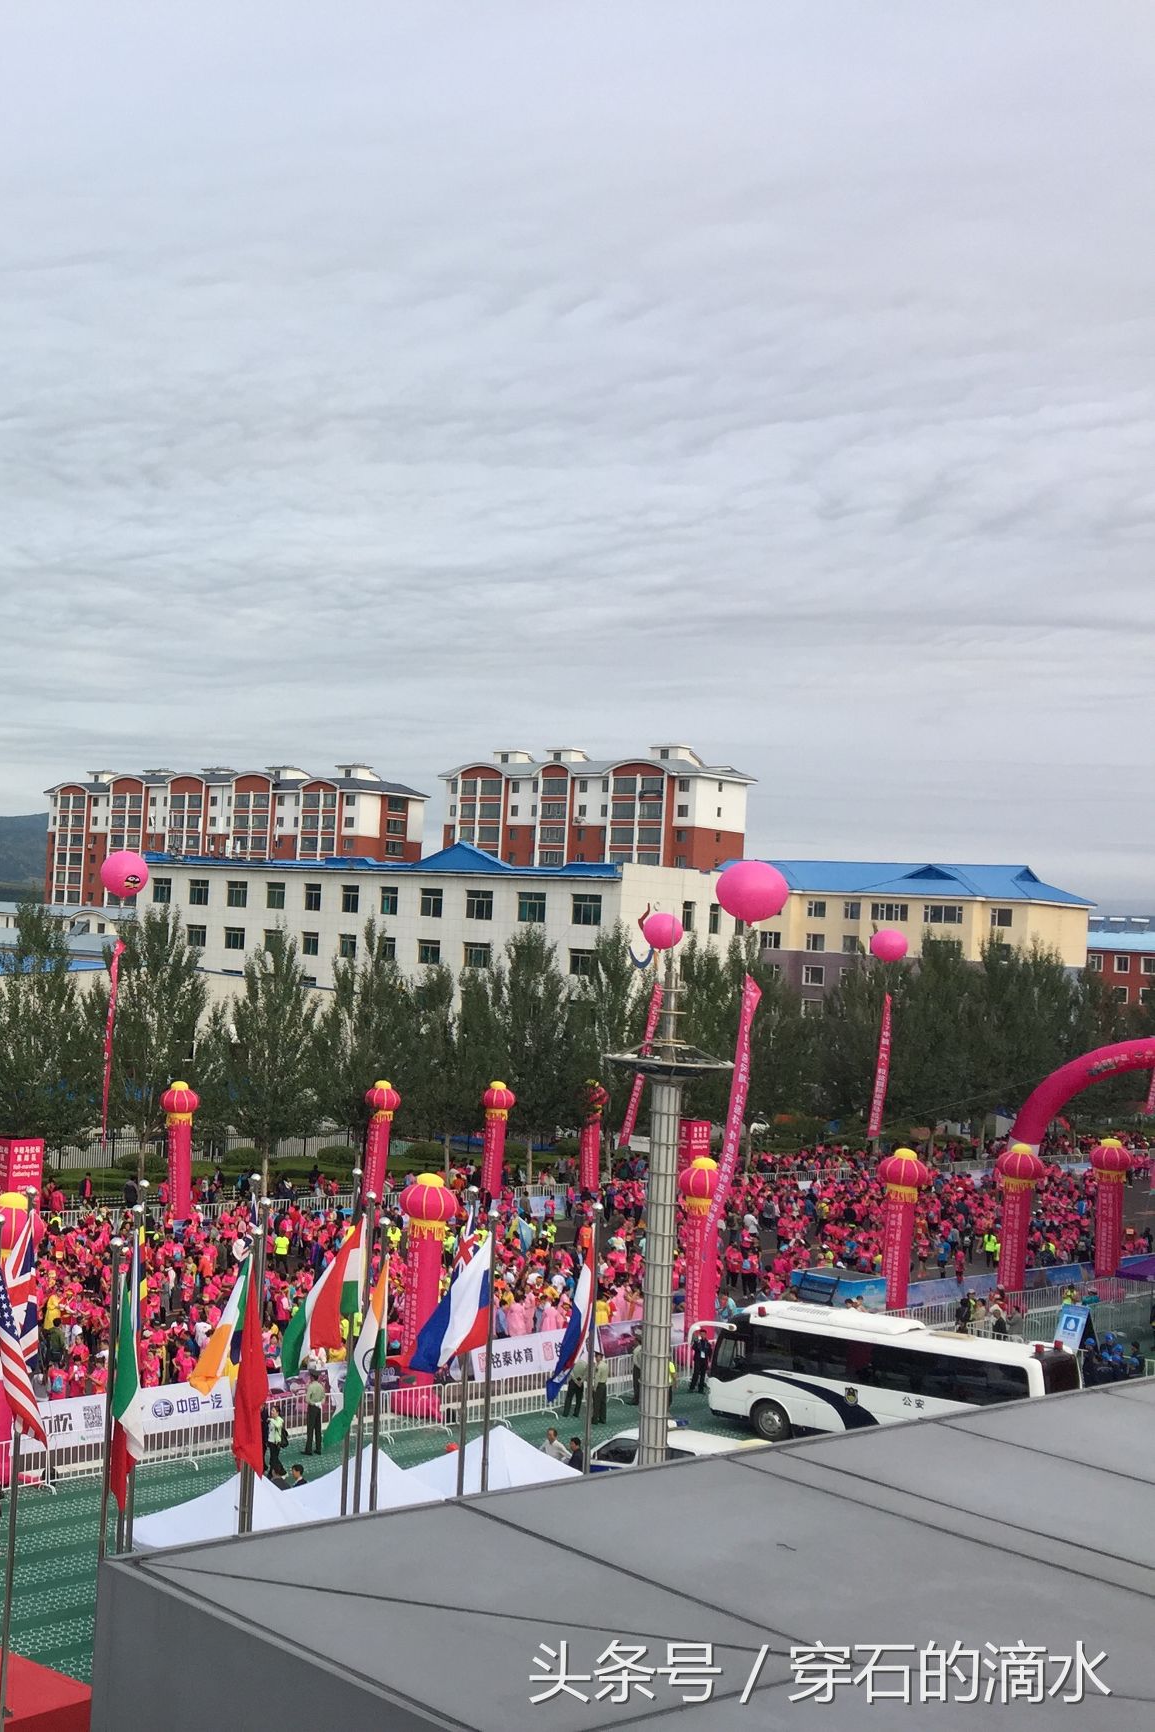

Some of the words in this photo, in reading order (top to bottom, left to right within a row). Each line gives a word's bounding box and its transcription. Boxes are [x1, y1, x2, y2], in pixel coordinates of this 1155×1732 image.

[176, 1393, 223, 1414] 中国一汽
[902, 1396, 925, 1410] 公安
